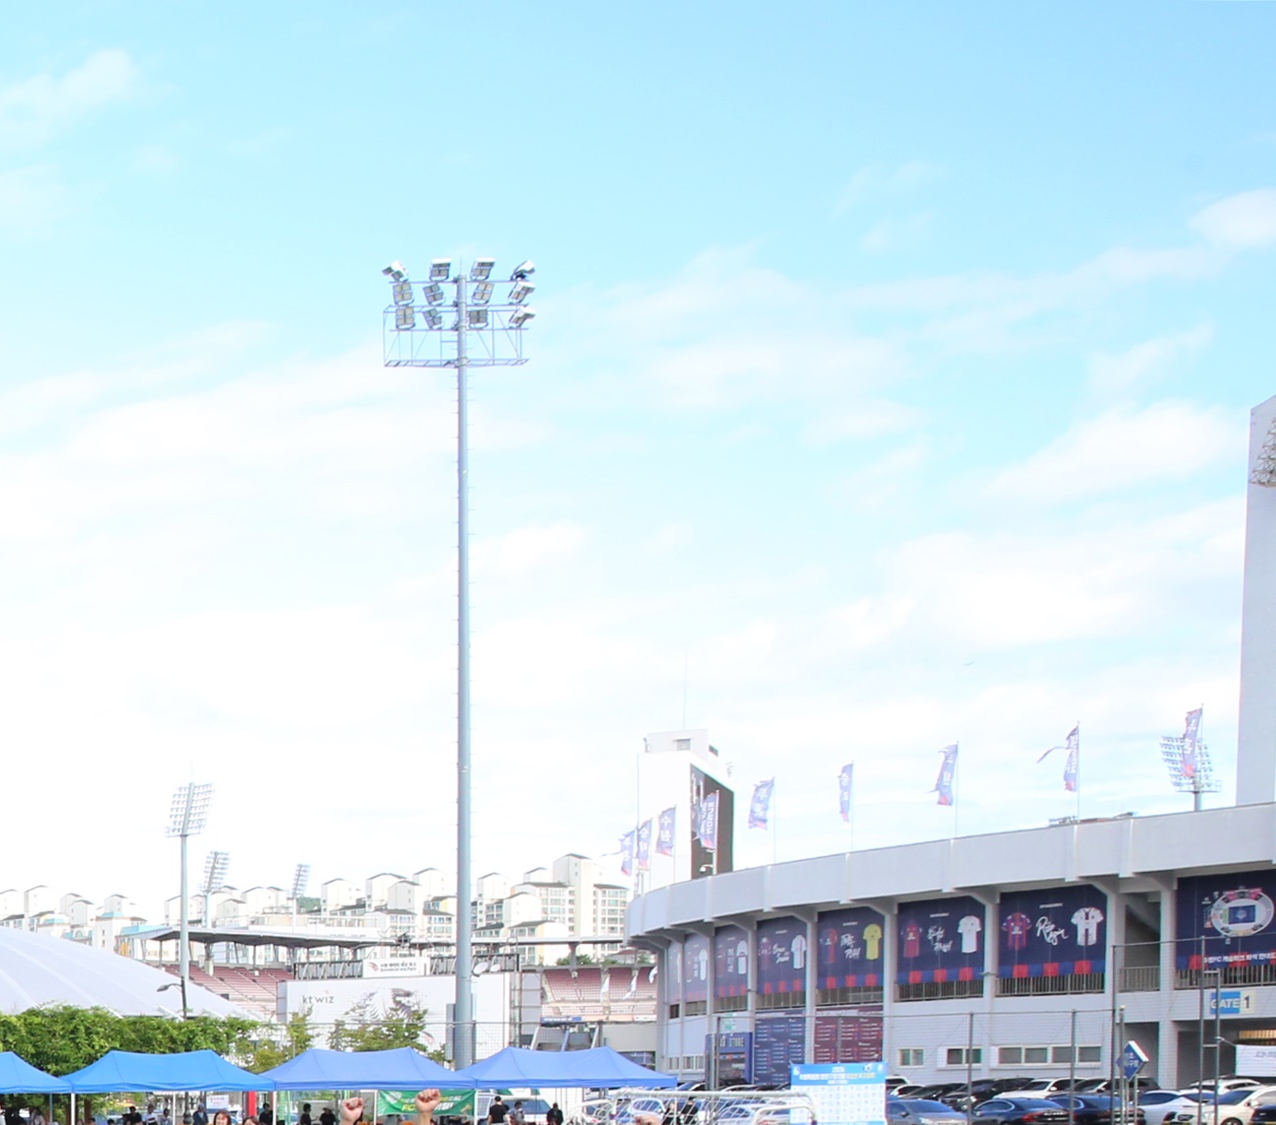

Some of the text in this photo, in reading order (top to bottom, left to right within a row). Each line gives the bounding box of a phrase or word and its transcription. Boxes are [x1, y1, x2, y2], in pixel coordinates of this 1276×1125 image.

[302, 994, 335, 1004] kt wiz
[1210, 995, 1251, 1009] GATE 1
